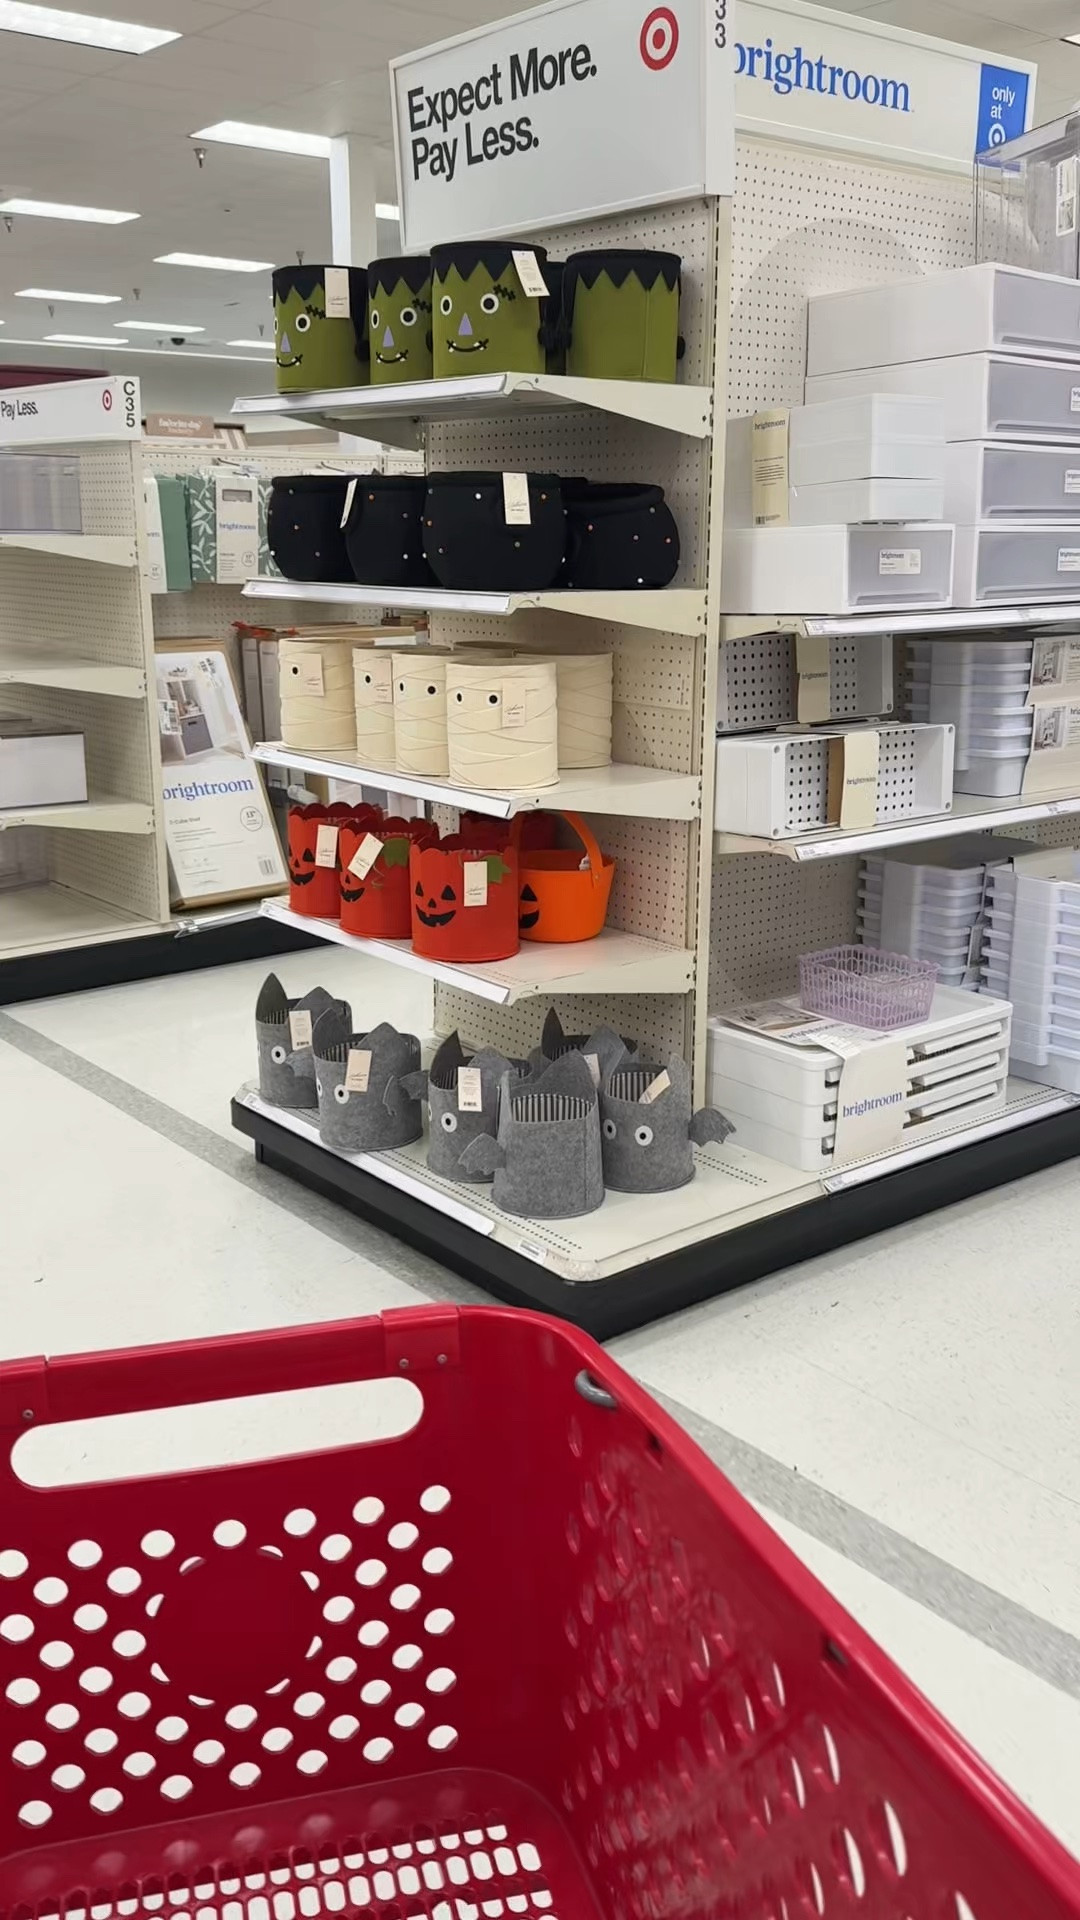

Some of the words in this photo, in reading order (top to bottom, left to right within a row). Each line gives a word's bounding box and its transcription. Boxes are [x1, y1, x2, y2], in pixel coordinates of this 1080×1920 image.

[407, 63, 503, 133] Expect
[509, 44, 598, 101] More.
[992, 85, 1016, 107] only
[991, 103, 1003, 119] at
[412, 136, 458, 182] Pay
[465, 116, 540, 166] Less.
[0, 401, 15, 420] Pay
[842, 1091, 903, 1118] brightroom
